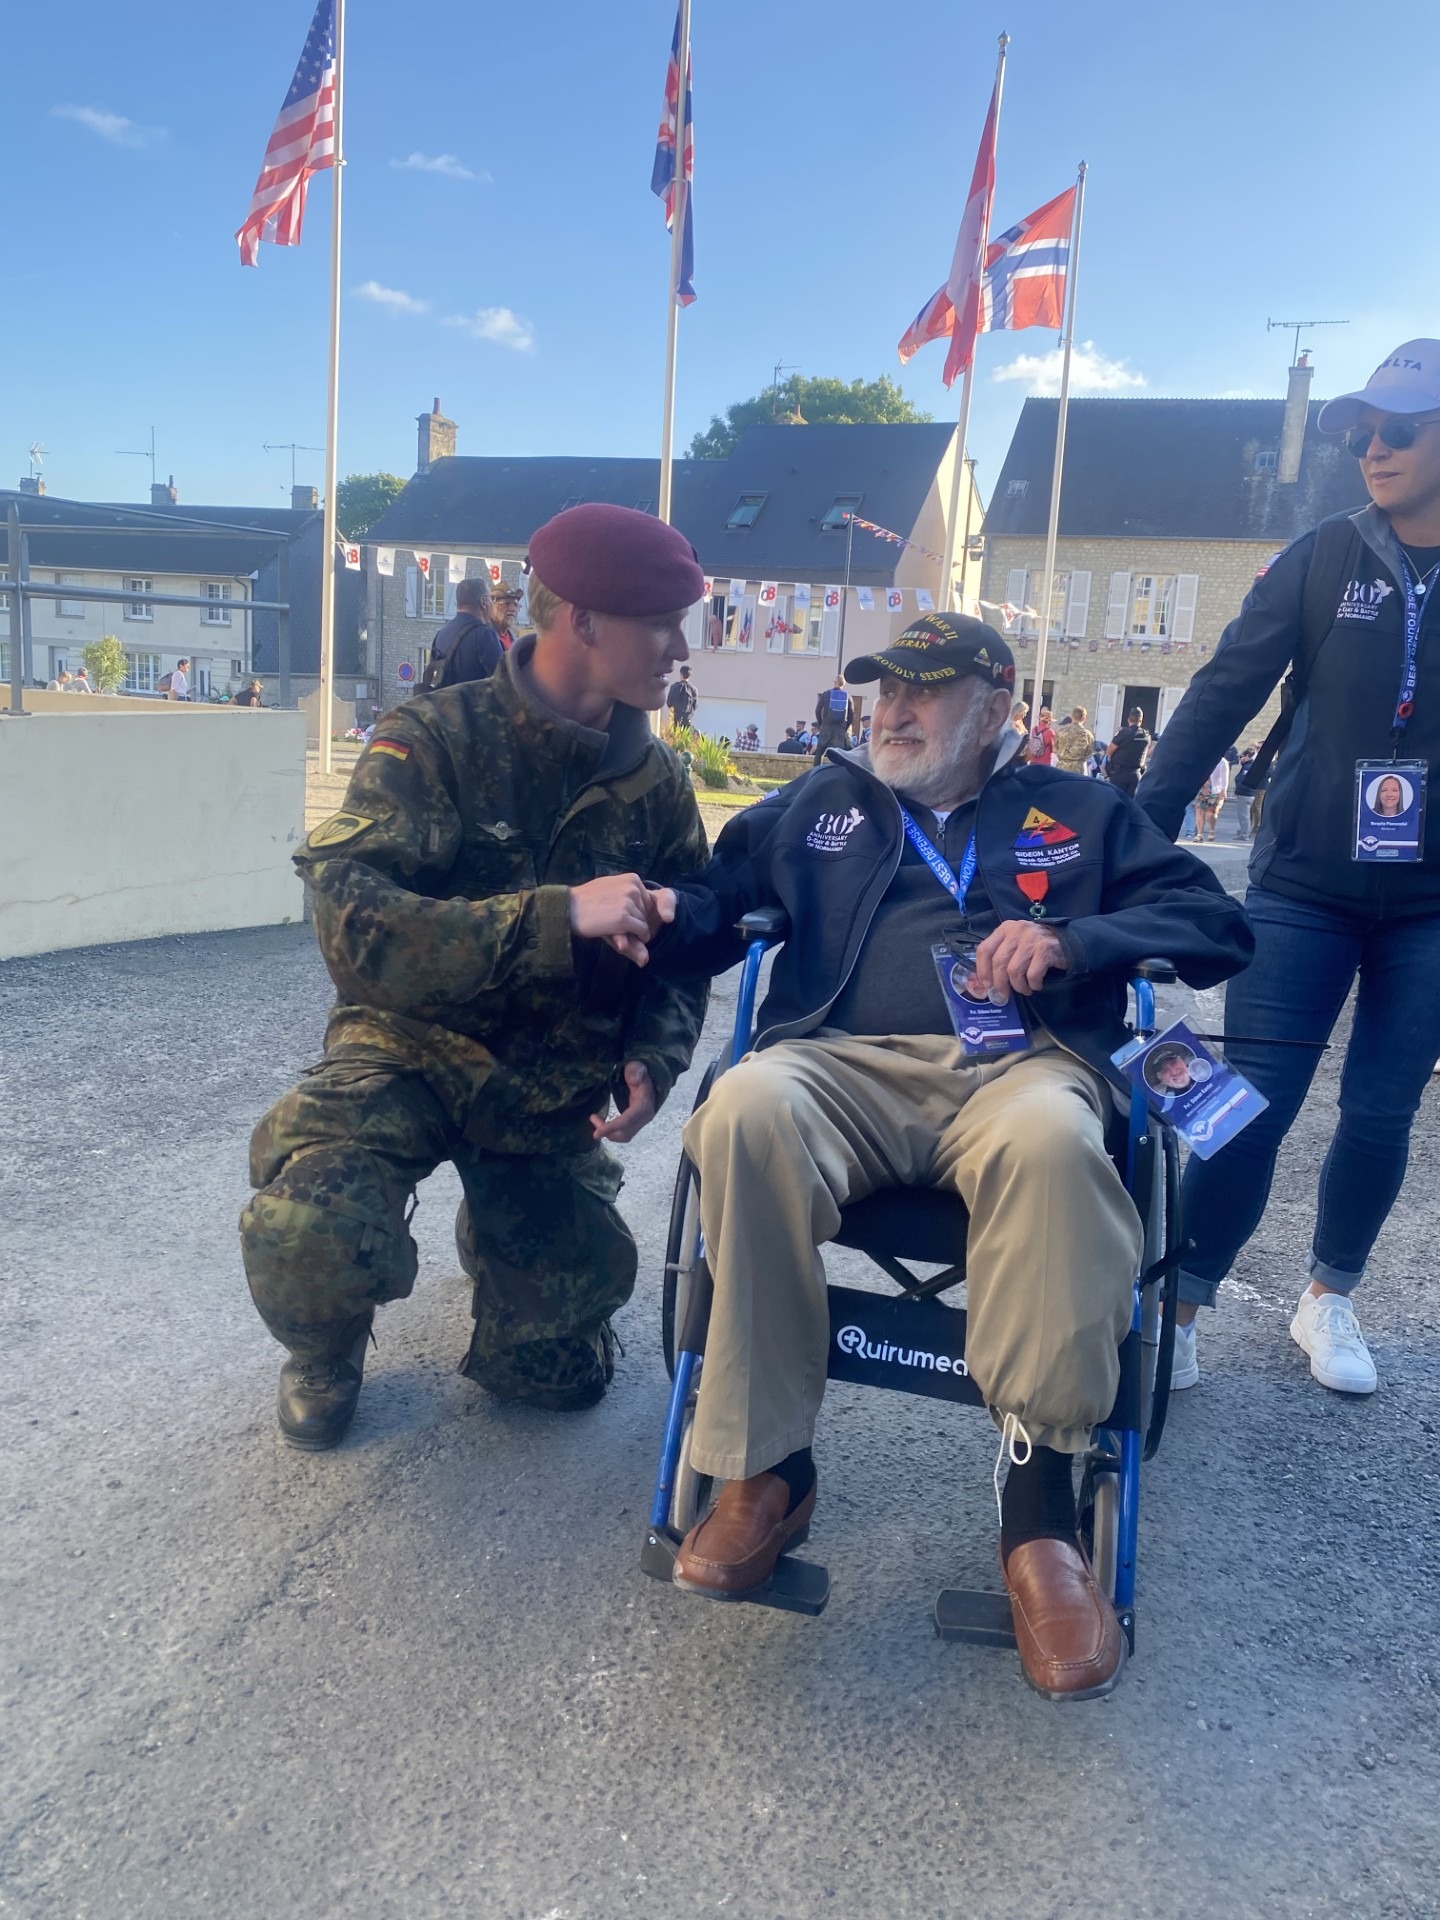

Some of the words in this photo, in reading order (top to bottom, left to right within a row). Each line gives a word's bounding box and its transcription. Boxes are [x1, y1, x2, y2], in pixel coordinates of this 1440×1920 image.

[919, 667, 956, 681] SERVED
[907, 826, 937, 861] DEFENSE
[1014, 850, 1044, 858] GIDEON
[1047, 843, 1080, 856] KANTOR
[932, 859, 951, 884] BEST
